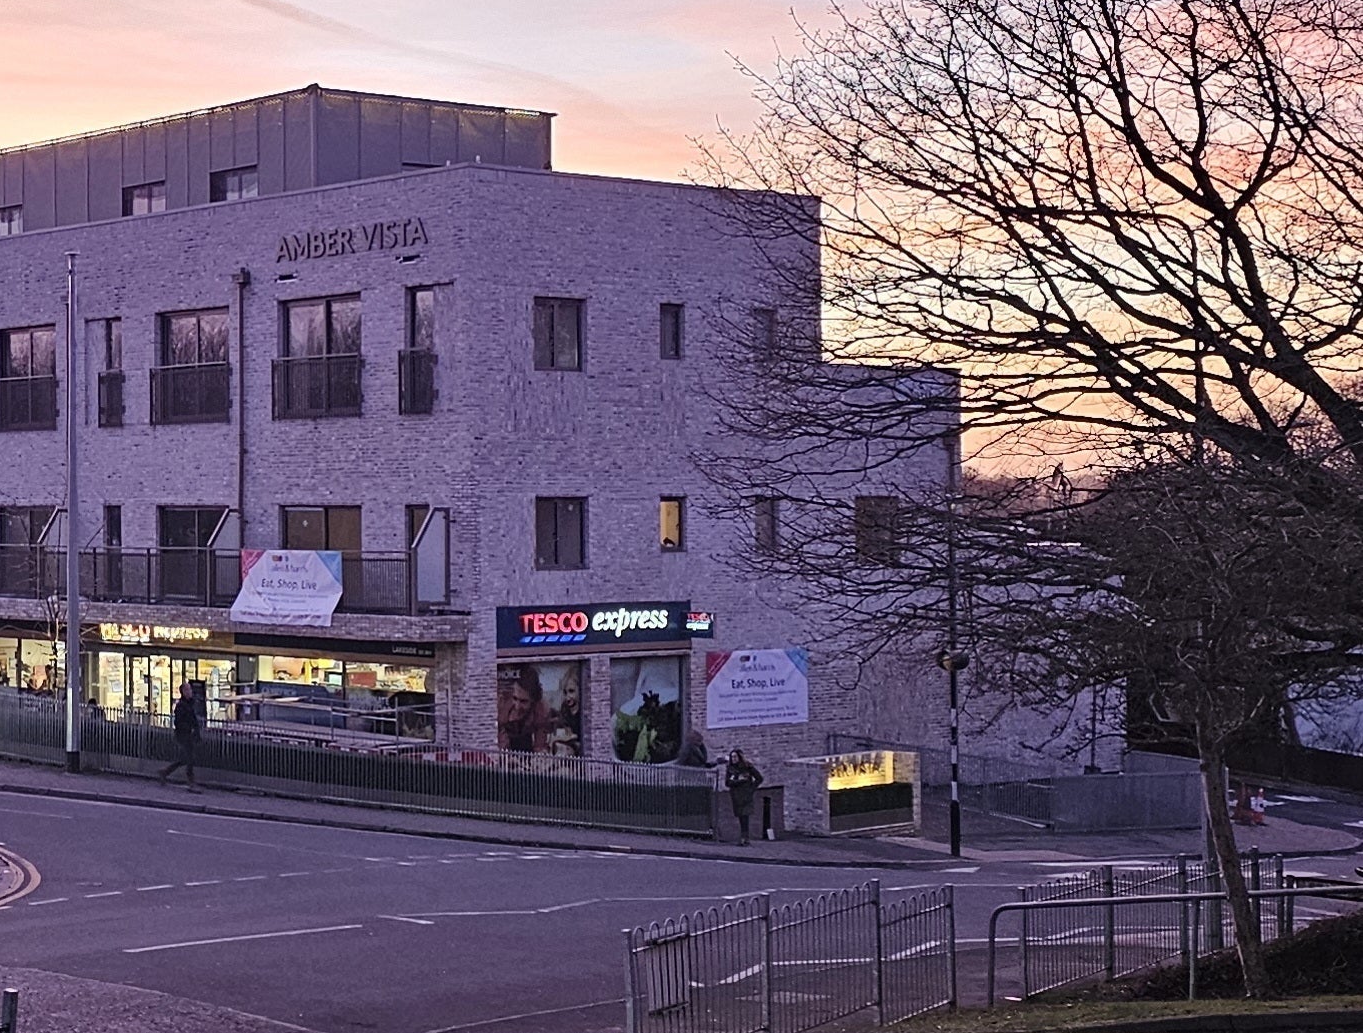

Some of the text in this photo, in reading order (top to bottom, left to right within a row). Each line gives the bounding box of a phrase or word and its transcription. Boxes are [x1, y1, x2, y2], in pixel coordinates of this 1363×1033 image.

[276, 217, 429, 264] AMBER VISTA
[301, 579, 318, 590] Live
[519, 608, 669, 637] TESCO express
[731, 677, 786, 690] Eat, Shop, Live
